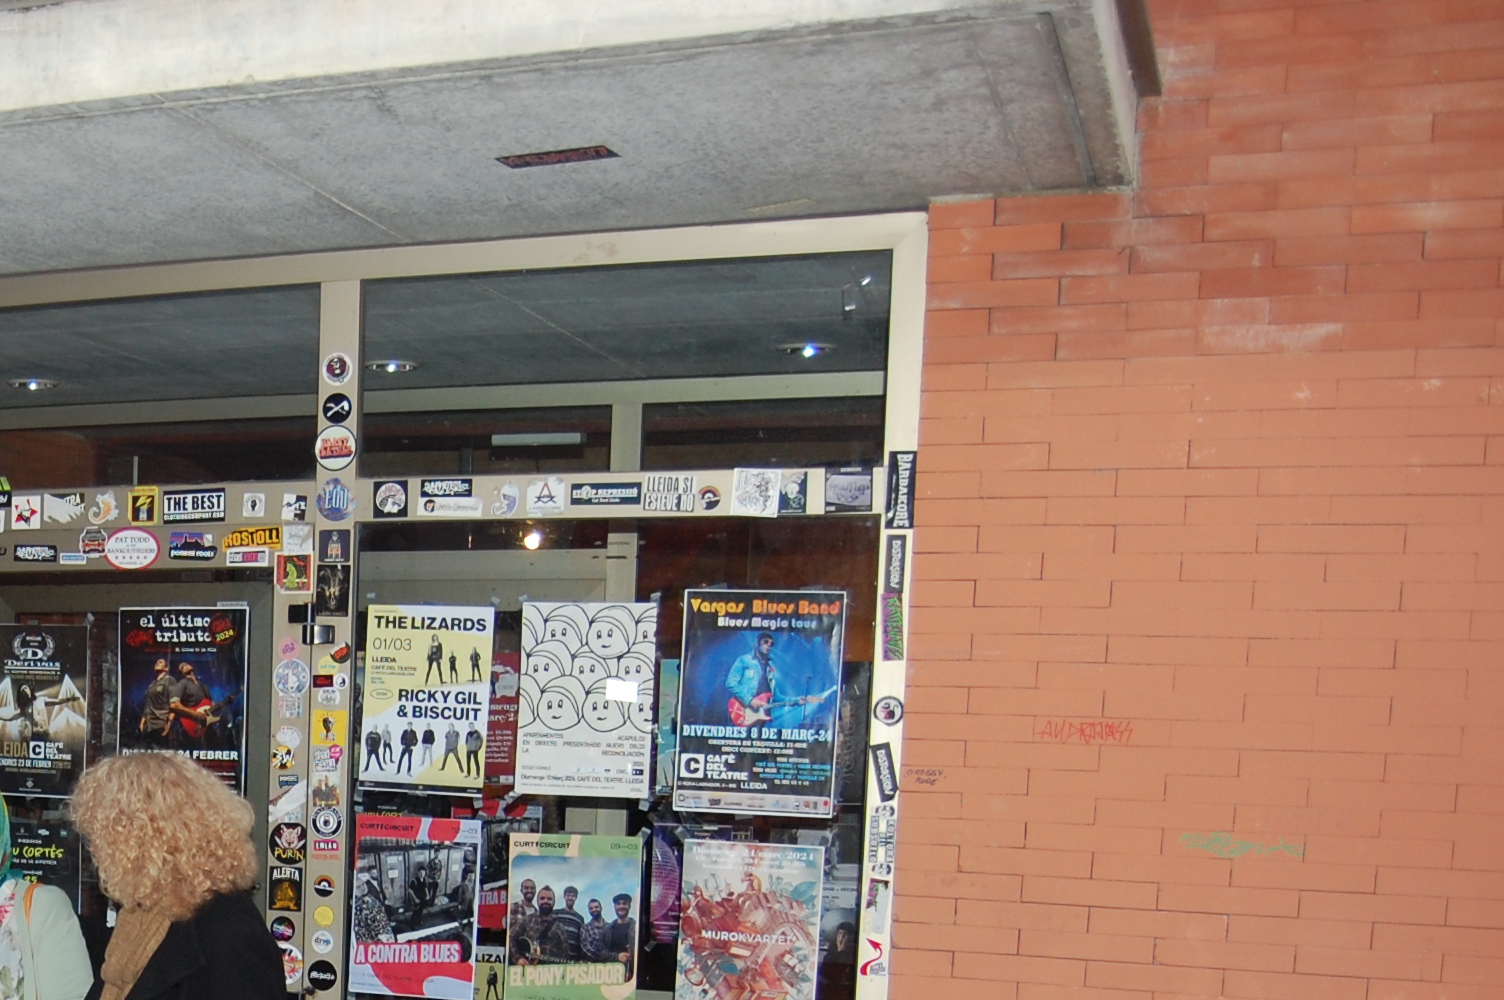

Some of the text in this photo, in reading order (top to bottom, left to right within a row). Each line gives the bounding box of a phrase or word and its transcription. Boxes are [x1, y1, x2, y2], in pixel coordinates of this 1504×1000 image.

[647, 476, 679, 494] LLEIDA
[166, 494, 222, 511] THE BEST
[644, 493, 694, 511] ESTEVE NO
[691, 599, 840, 616] Vargas Blues Band
[140, 614, 211, 627] el último
[374, 615, 487, 632] THE LIZARDS
[718, 617, 748, 627] Blues
[155, 630, 212, 642] tributo
[373, 637, 412, 651] 01/03
[398, 689, 483, 705] RICKY GIL
[397, 705, 408, 718] &
[412, 706, 481, 721] BISCUIT
[683, 725, 746, 738] DIVENDRES
[750, 729, 758, 738] 8
[761, 729, 778, 739] DE
[193, 750, 239, 760] FEBRER
[706, 763, 726, 771] DEL
[707, 772, 748, 780] TEATRE
[23, 844, 64, 859] CORTÉS
[273, 867, 300, 882] ALERTA
[701, 930, 796, 945] MUROKVARTET
[356, 944, 459, 962] A CONTRA BLUES
[509, 965, 623, 986] EL PONY PISADOR
